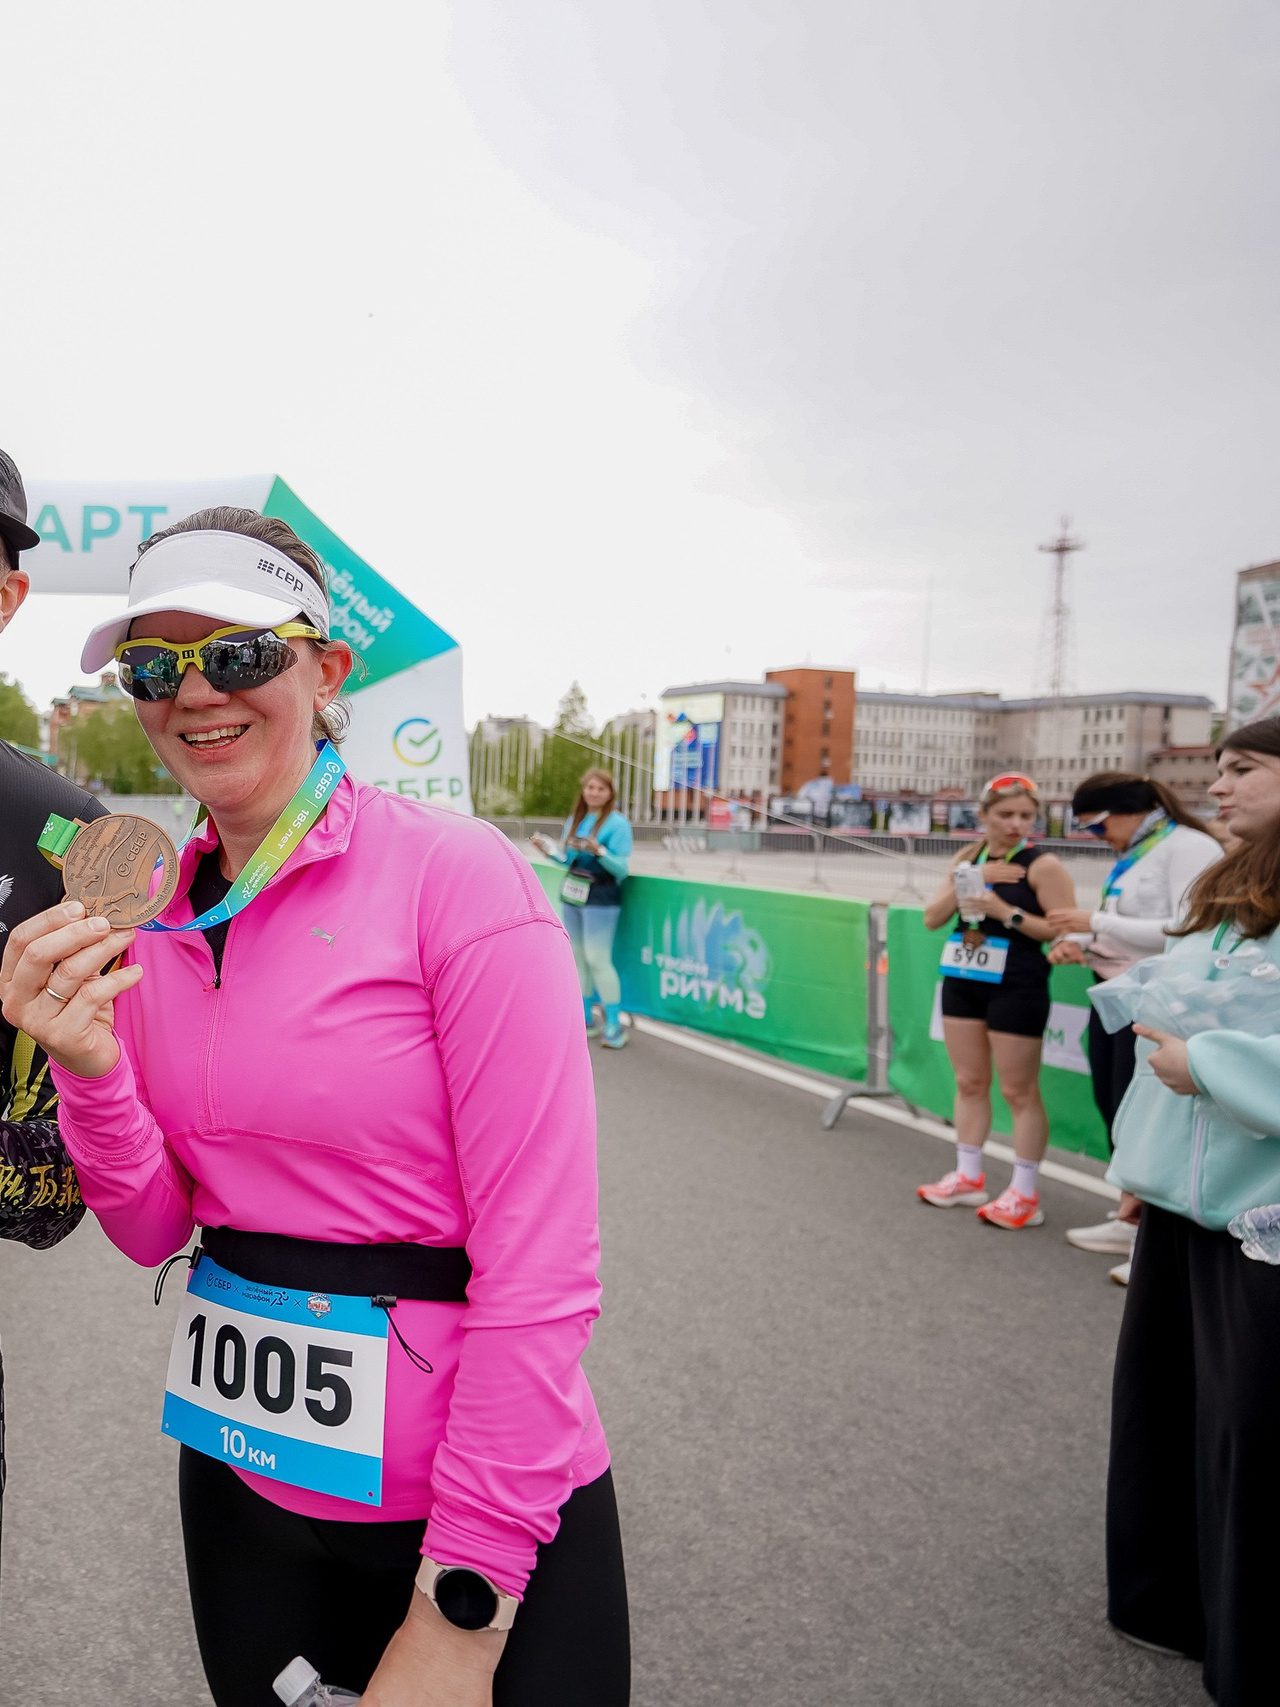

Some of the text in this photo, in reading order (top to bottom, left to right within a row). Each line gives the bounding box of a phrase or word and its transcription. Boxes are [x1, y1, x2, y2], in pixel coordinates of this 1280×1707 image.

[275, 566, 304, 592] cep
[314, 773, 333, 800] СБЕР
[277, 809, 310, 850] 185 лет
[126, 832, 147, 861] СБЕР
[213, 1278, 232, 1291] СБЕР
[187, 1313, 353, 1427] 1005
